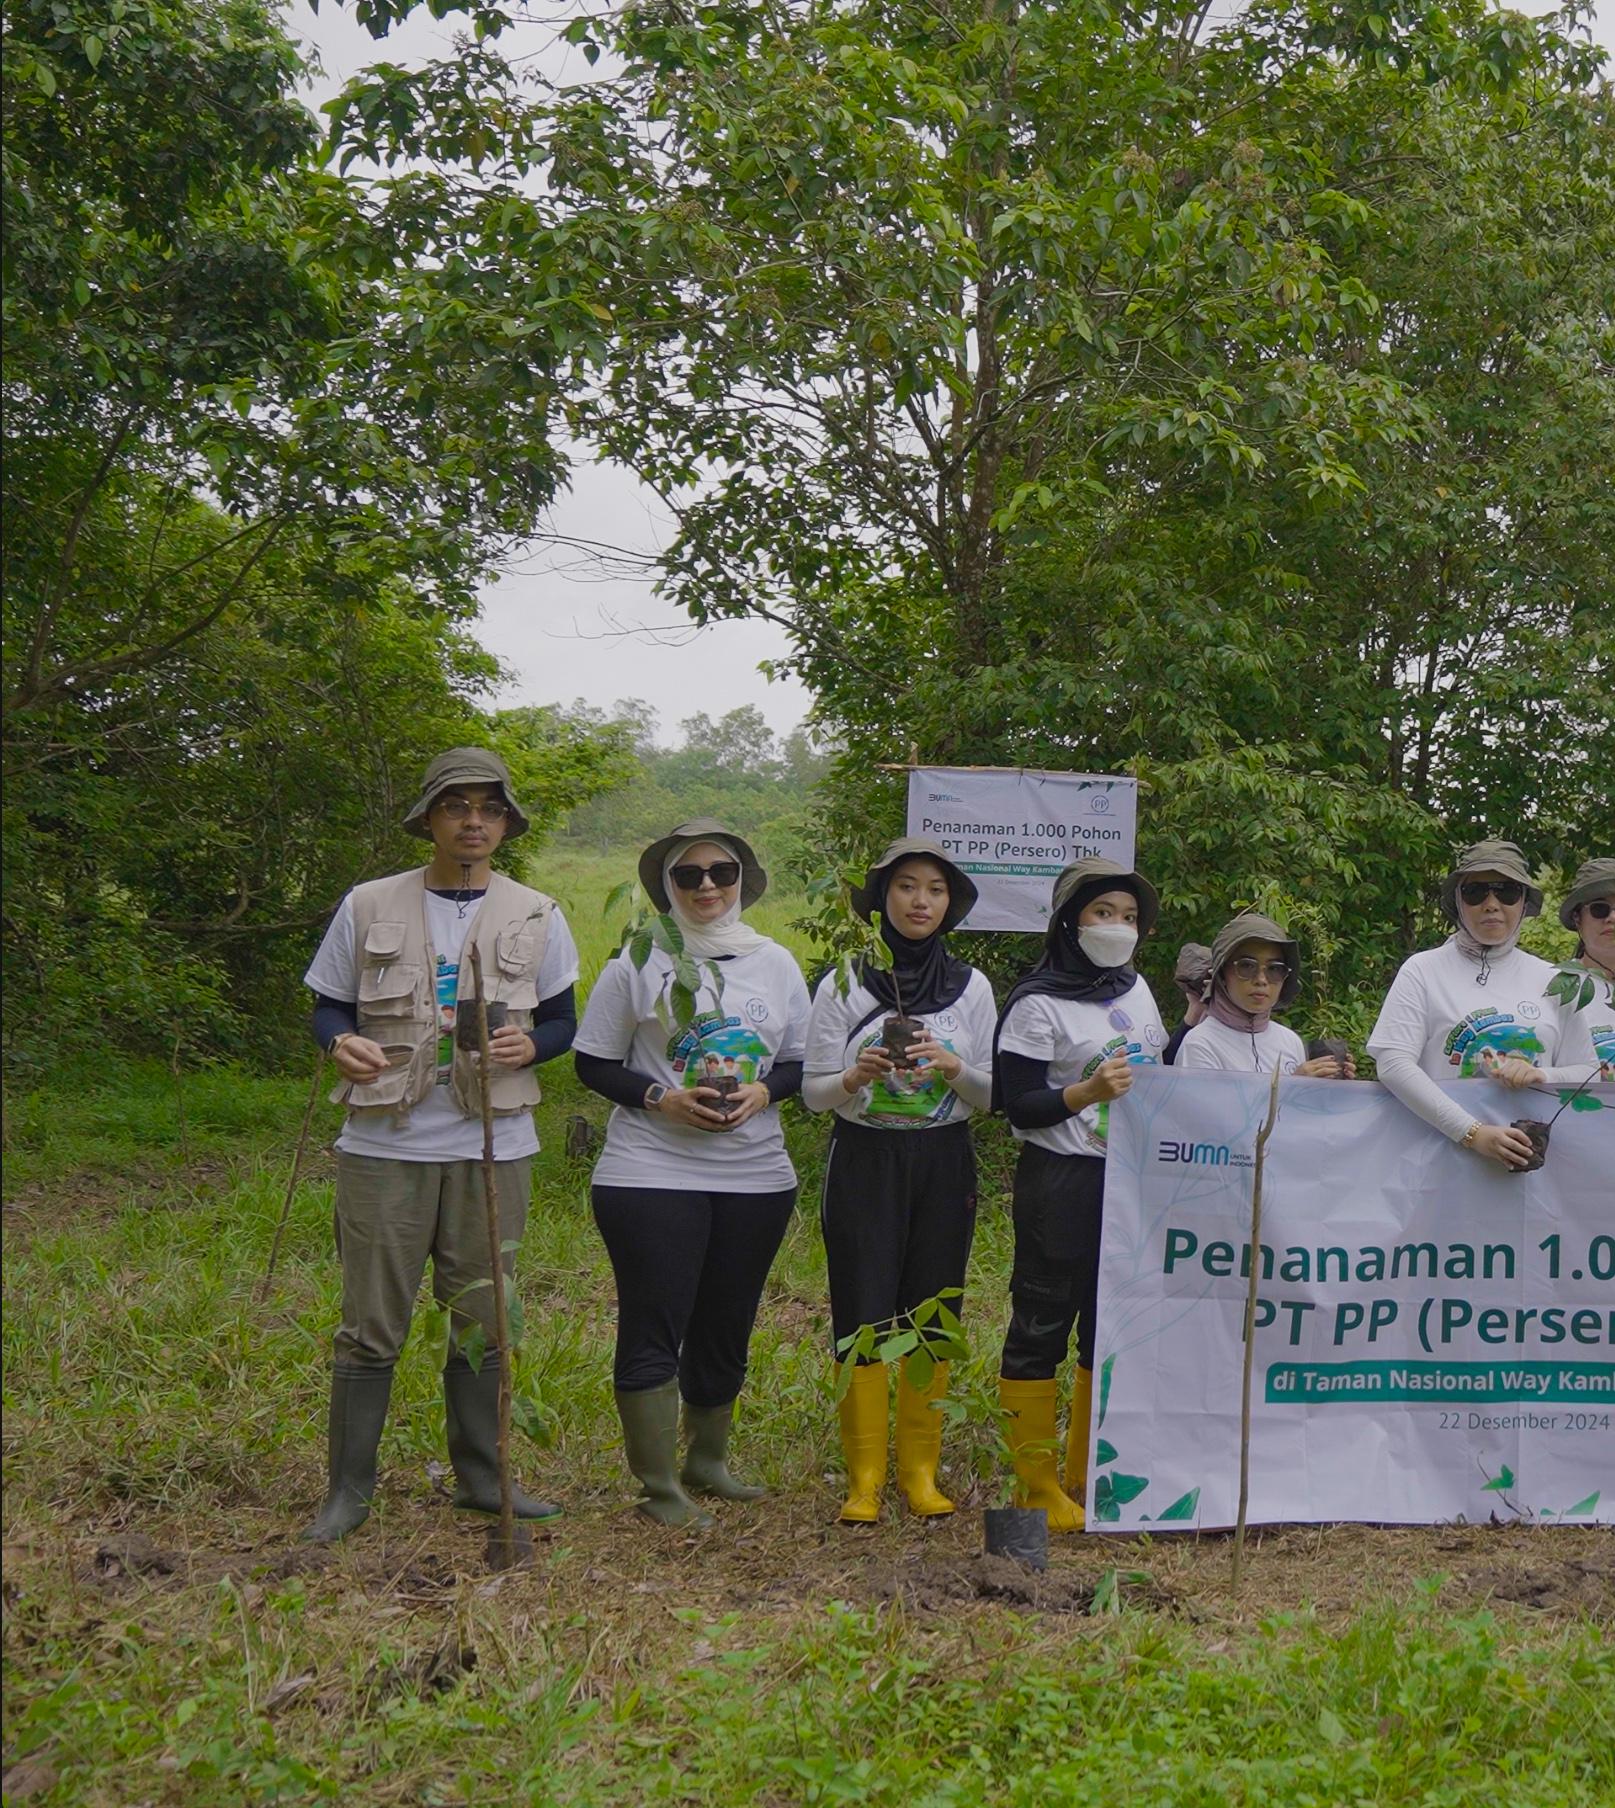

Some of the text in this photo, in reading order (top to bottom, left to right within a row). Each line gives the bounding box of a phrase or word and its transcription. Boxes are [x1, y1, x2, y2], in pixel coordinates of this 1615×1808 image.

[922, 818, 1121, 841] Penanaman 1.000 Pohon
[968, 841, 989, 854] PP
[995, 842, 1066, 860] (Persero)
[1013, 865, 1031, 874] Way
[1163, 1228, 1516, 1283] Penanaman
[1242, 1298, 1316, 1346] PT
[1333, 1299, 1399, 1347] PP
[1273, 1370, 1296, 1391] di
[1303, 1371, 1382, 1392] Taman
[1390, 1370, 1495, 1391] Nasional
[1501, 1371, 1552, 1395] Way
[1439, 1412, 1610, 1431] 22 Desember 2024
